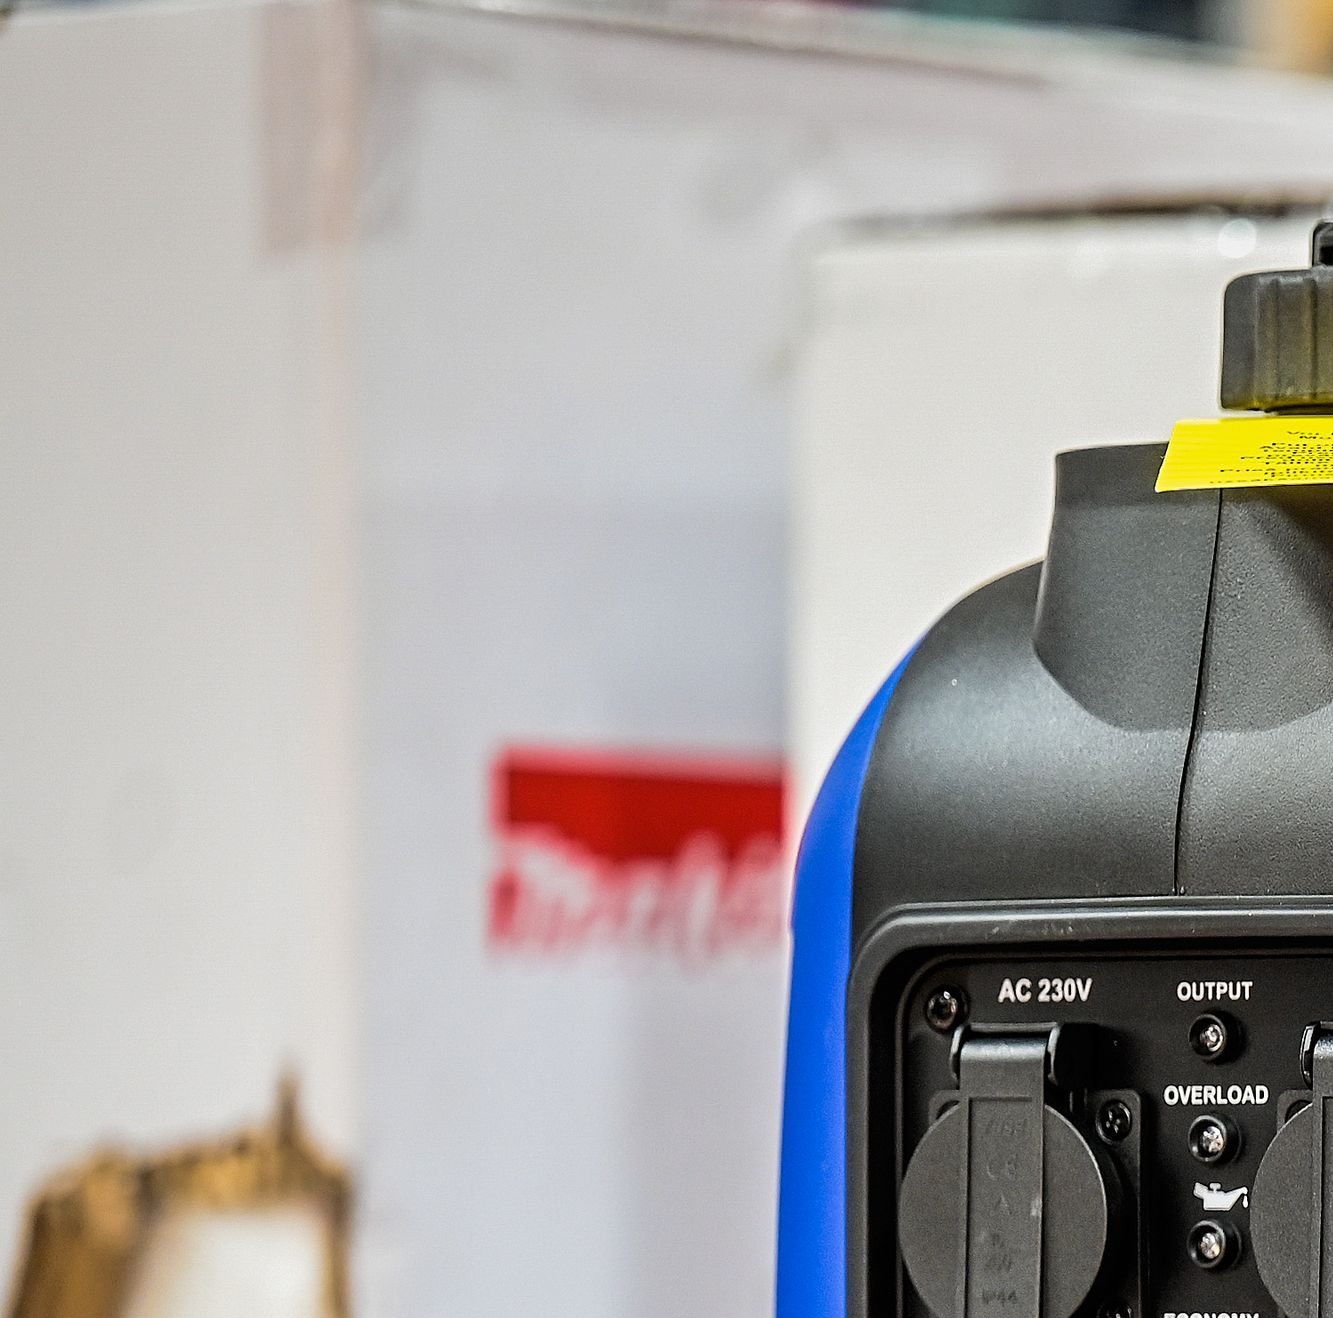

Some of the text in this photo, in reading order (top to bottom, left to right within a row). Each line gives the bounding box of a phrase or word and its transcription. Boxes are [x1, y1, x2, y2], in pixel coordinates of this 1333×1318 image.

[998, 977, 1093, 1002] AC 230V
[1176, 981, 1253, 1002] OUTPUT
[1163, 1084, 1269, 1106] OVERLOAD
